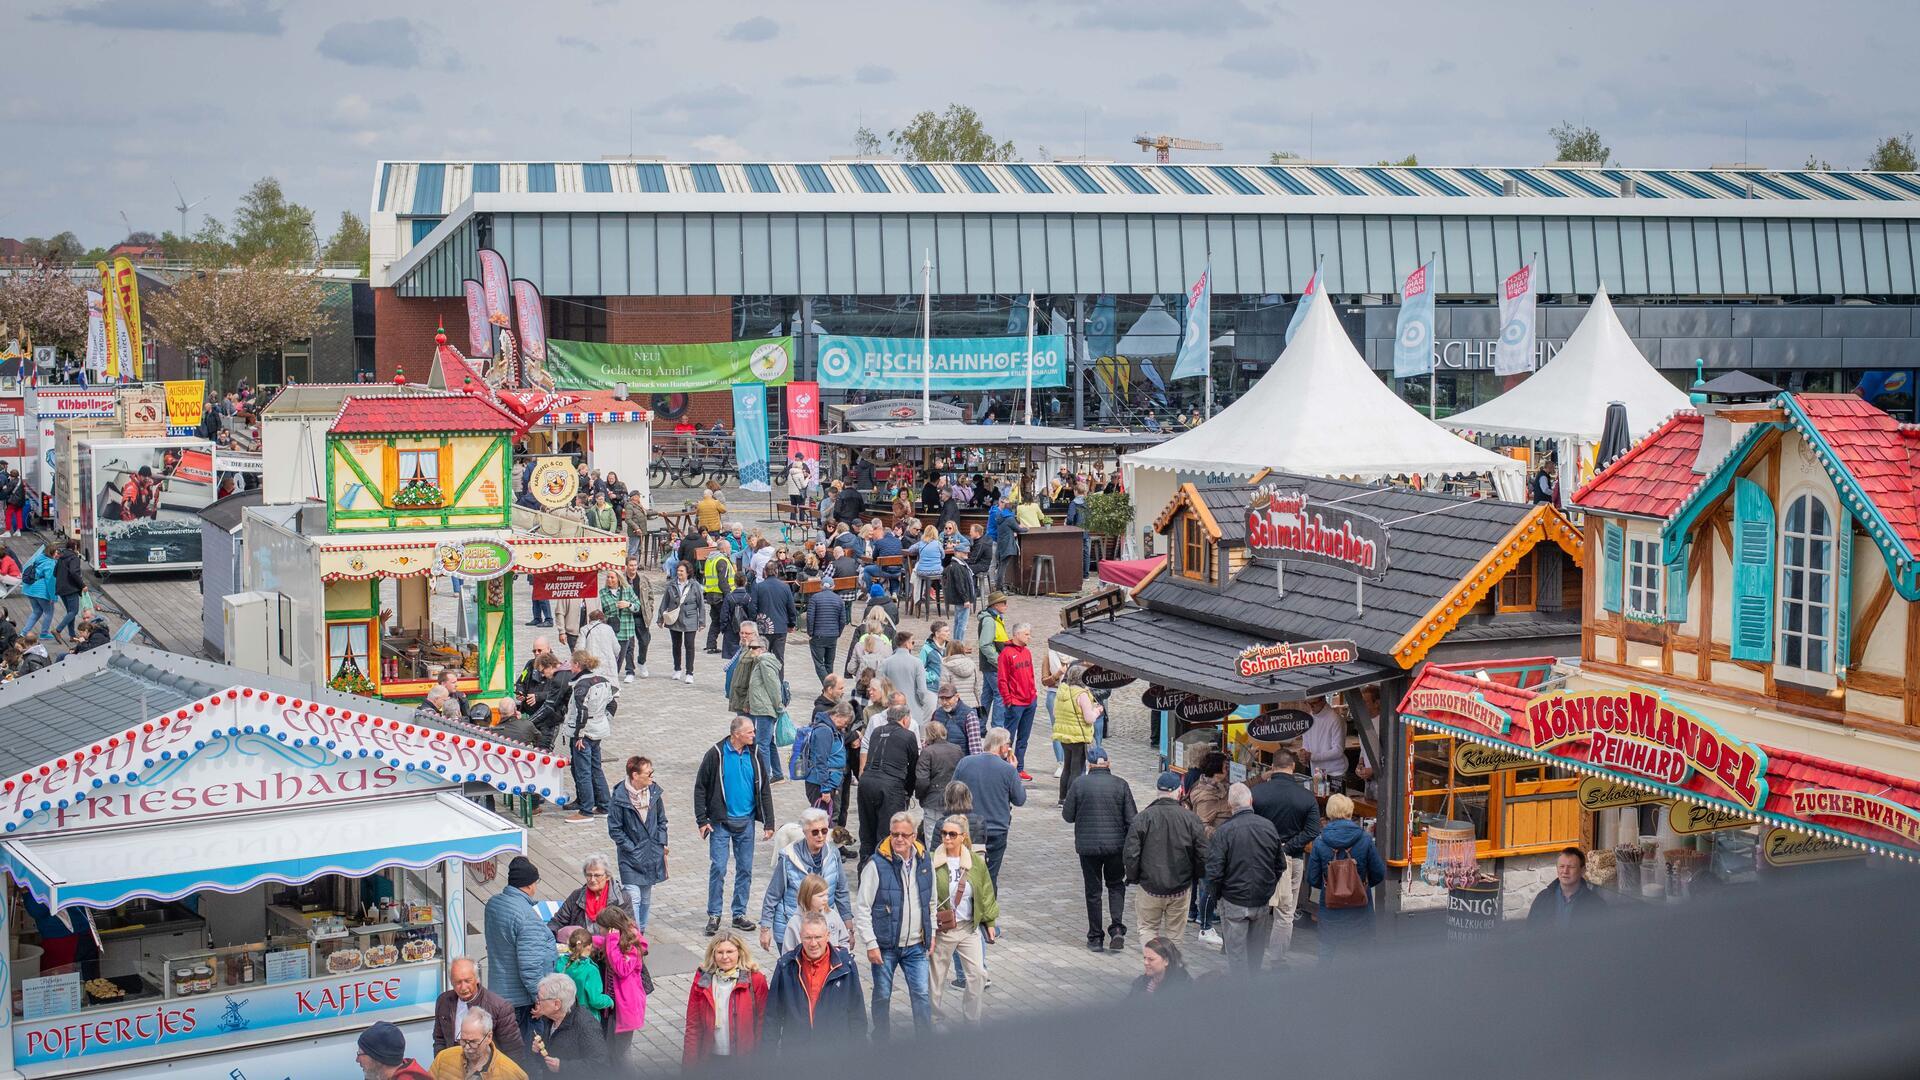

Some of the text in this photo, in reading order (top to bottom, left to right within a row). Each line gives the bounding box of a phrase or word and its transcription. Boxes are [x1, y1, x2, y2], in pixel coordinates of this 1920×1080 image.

[634, 351, 660, 361] NEU!
[601, 363, 693, 376] Gelateria Amalfi
[169, 397, 201, 422] Crêpes
[1250, 510, 1377, 570] Schmalzkuchen
[463, 557, 501, 570] KUCHEN
[545, 582, 587, 591] KARTOFFEL-
[551, 589, 579, 598] PUFFER
[1241, 645, 1350, 676] Schmalzkuchen
[1412, 693, 1503, 731] SCHOKOFRÜCHTE
[1252, 719, 1310, 738] SCHMALZKUCHEN
[1588, 731, 1685, 785] REINHARD
[1794, 791, 1920, 838] ZUCKERWATT
[295, 978, 401, 1017] KAFFEE
